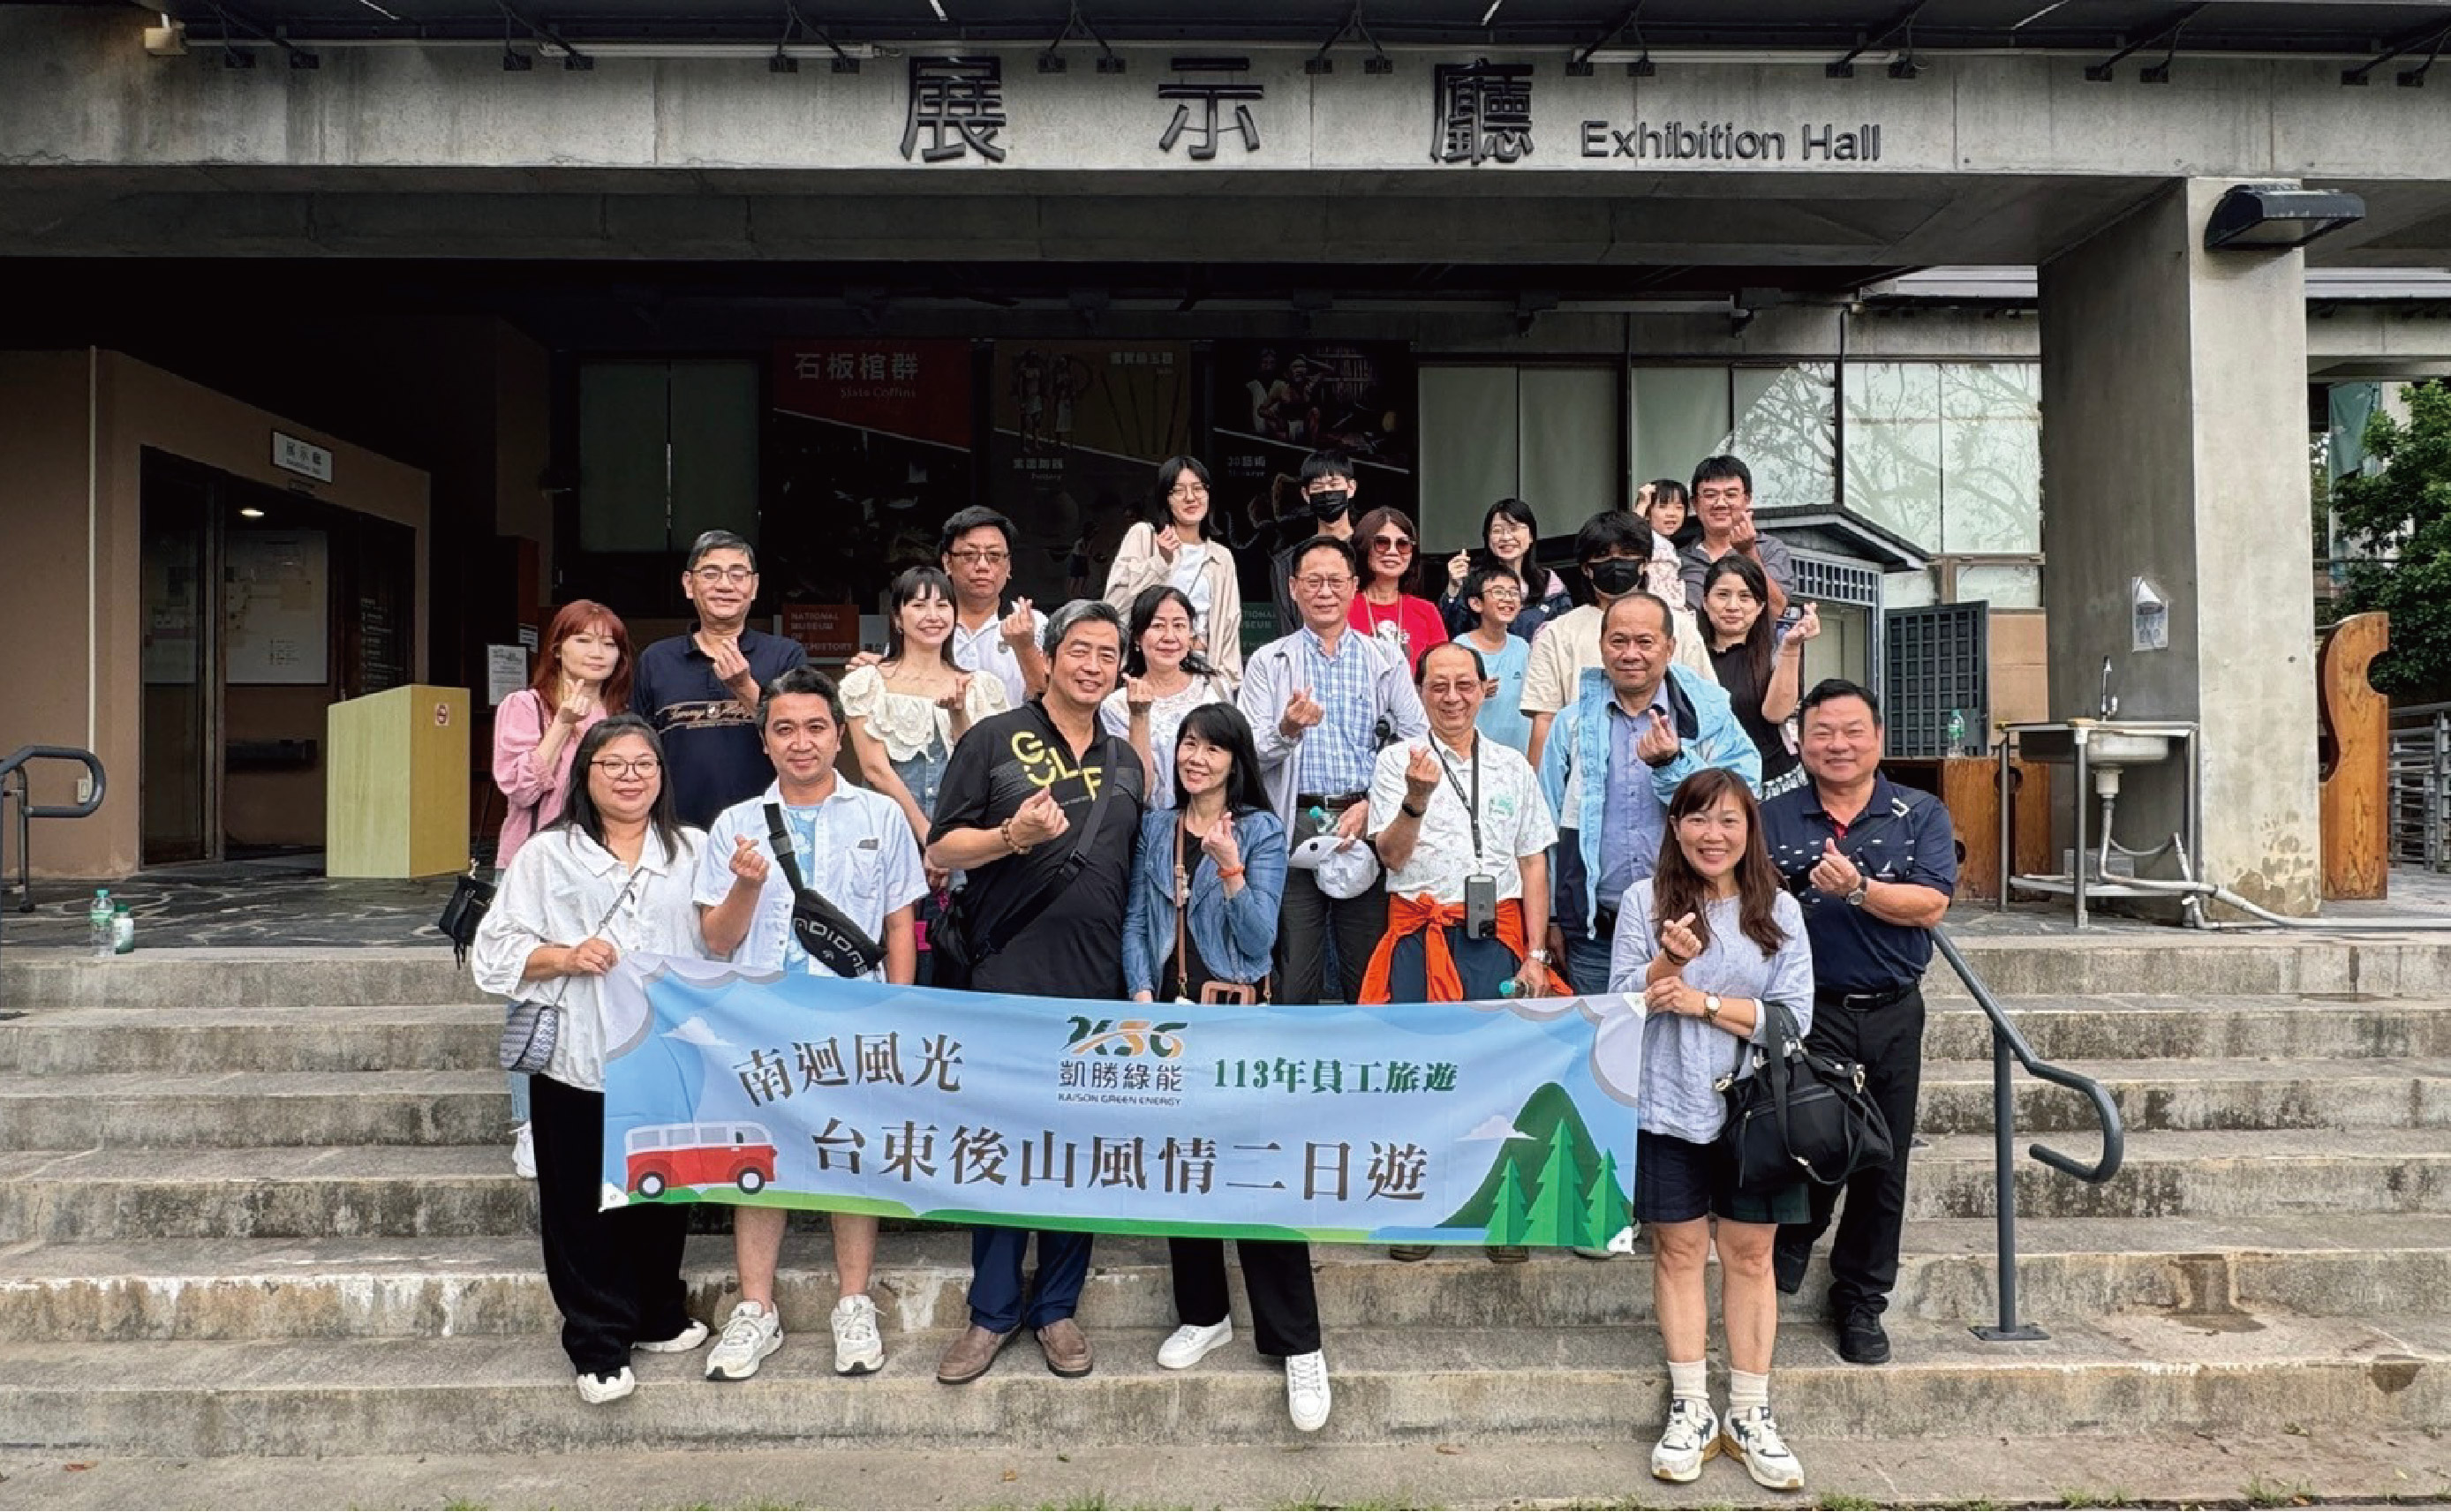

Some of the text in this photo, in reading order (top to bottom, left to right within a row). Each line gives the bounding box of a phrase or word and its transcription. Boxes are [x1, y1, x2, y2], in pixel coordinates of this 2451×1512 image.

[901, 56, 1535, 164] 展示廳
[1580, 120, 1882, 162] Exhibition Hall
[794, 351, 919, 380] 石板棺群
[790, 612, 839, 621] NATIONAL
[732, 1031, 964, 1108] 南迴風光
[1058, 1059, 1183, 1092] 凱勝綠能
[1213, 1057, 1458, 1095] 113年員工旅遊
[1058, 1093, 1099, 1102] KAISON
[811, 1117, 1428, 1203] 台東後山風情二日遊
